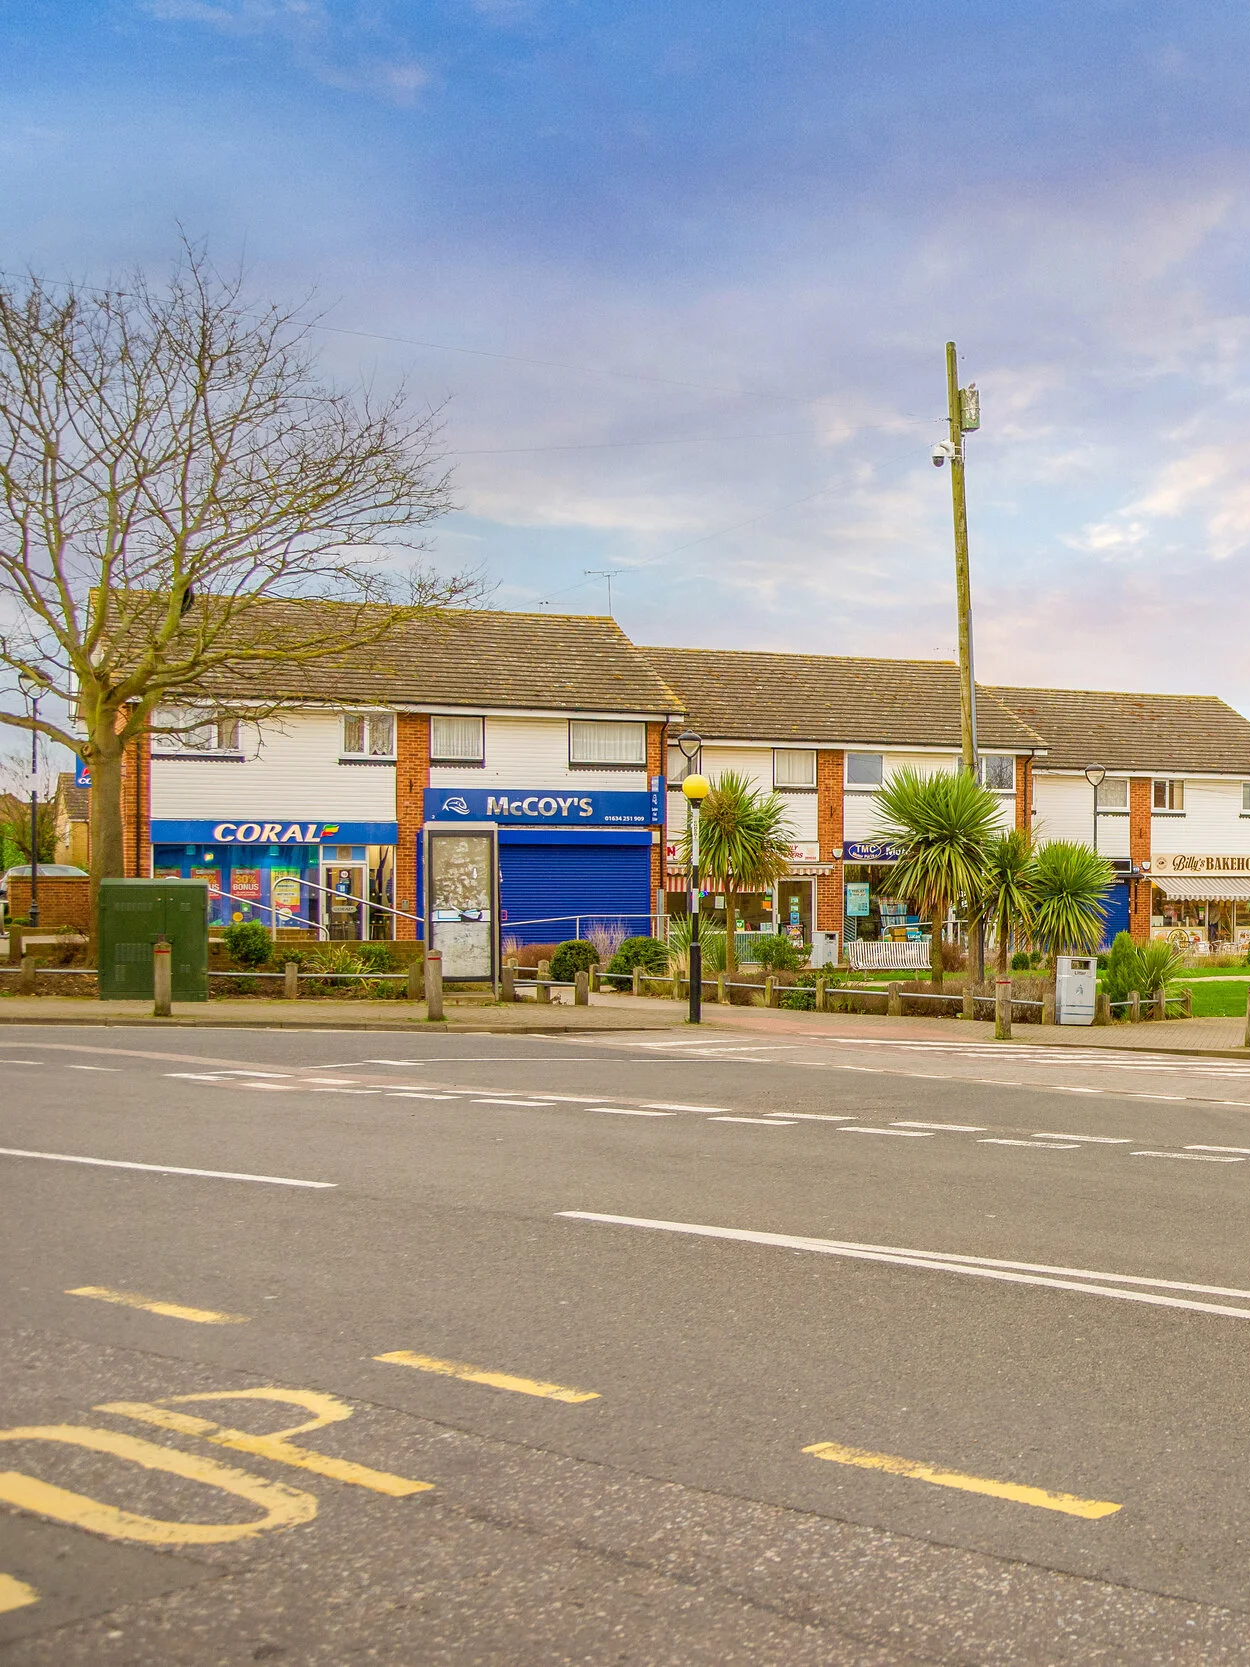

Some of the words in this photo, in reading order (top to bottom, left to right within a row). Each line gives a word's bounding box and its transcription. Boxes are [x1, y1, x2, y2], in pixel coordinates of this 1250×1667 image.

[486, 796, 594, 817] McCOY'S
[213, 823, 321, 843] CORAL
[855, 844, 877, 853] TMC
[1172, 855, 1206, 872] Billy's
[234, 874, 257, 884] 30%
[232, 883, 259, 891] BONUS
